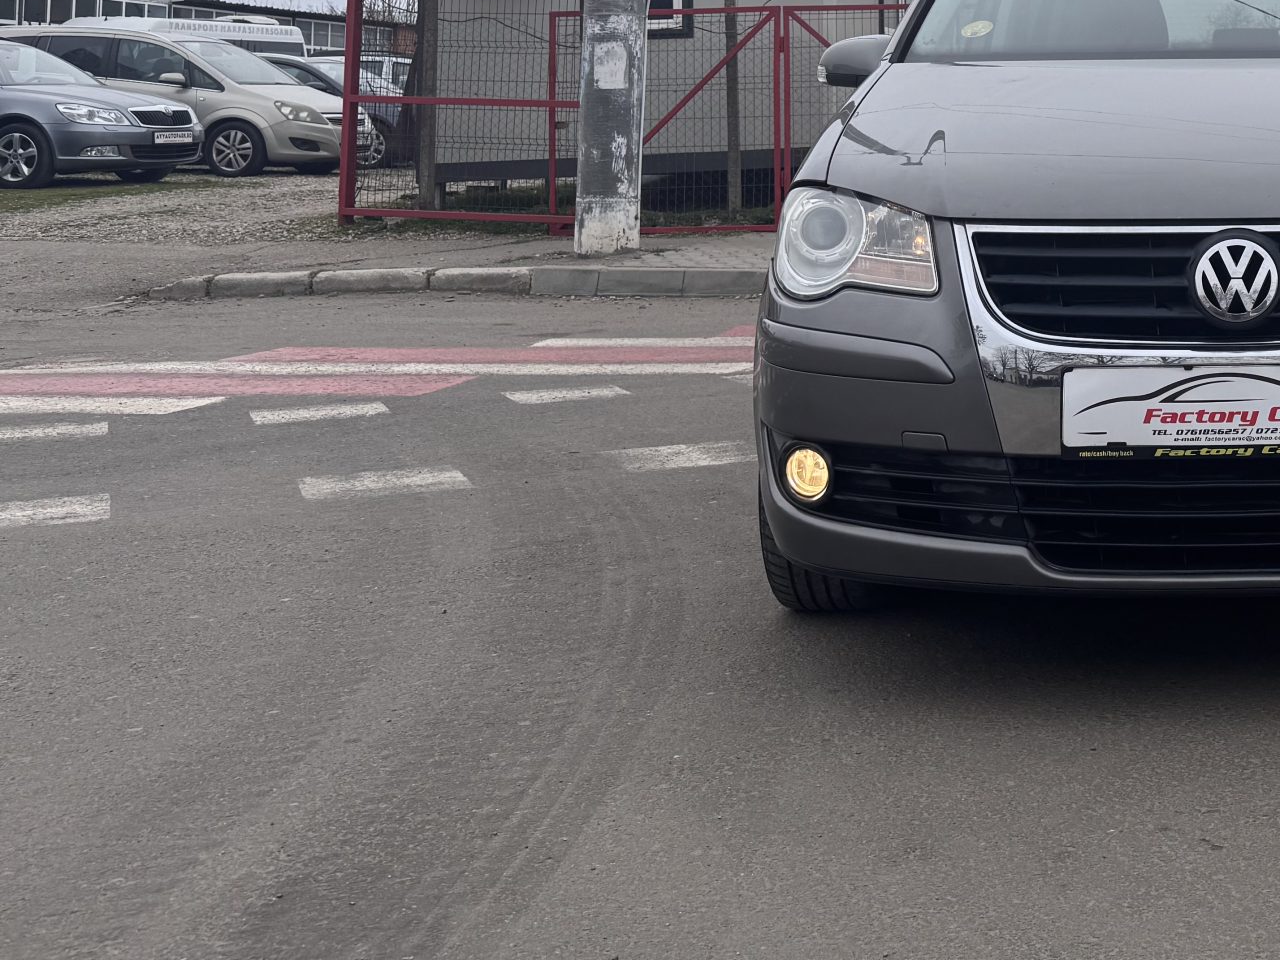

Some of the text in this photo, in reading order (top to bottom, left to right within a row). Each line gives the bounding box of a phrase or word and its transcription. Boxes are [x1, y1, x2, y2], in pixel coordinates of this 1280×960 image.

[169, 21, 218, 33] TRANSPORT
[1143, 408, 1260, 427] Factory
[1154, 447, 1255, 457] Factory
